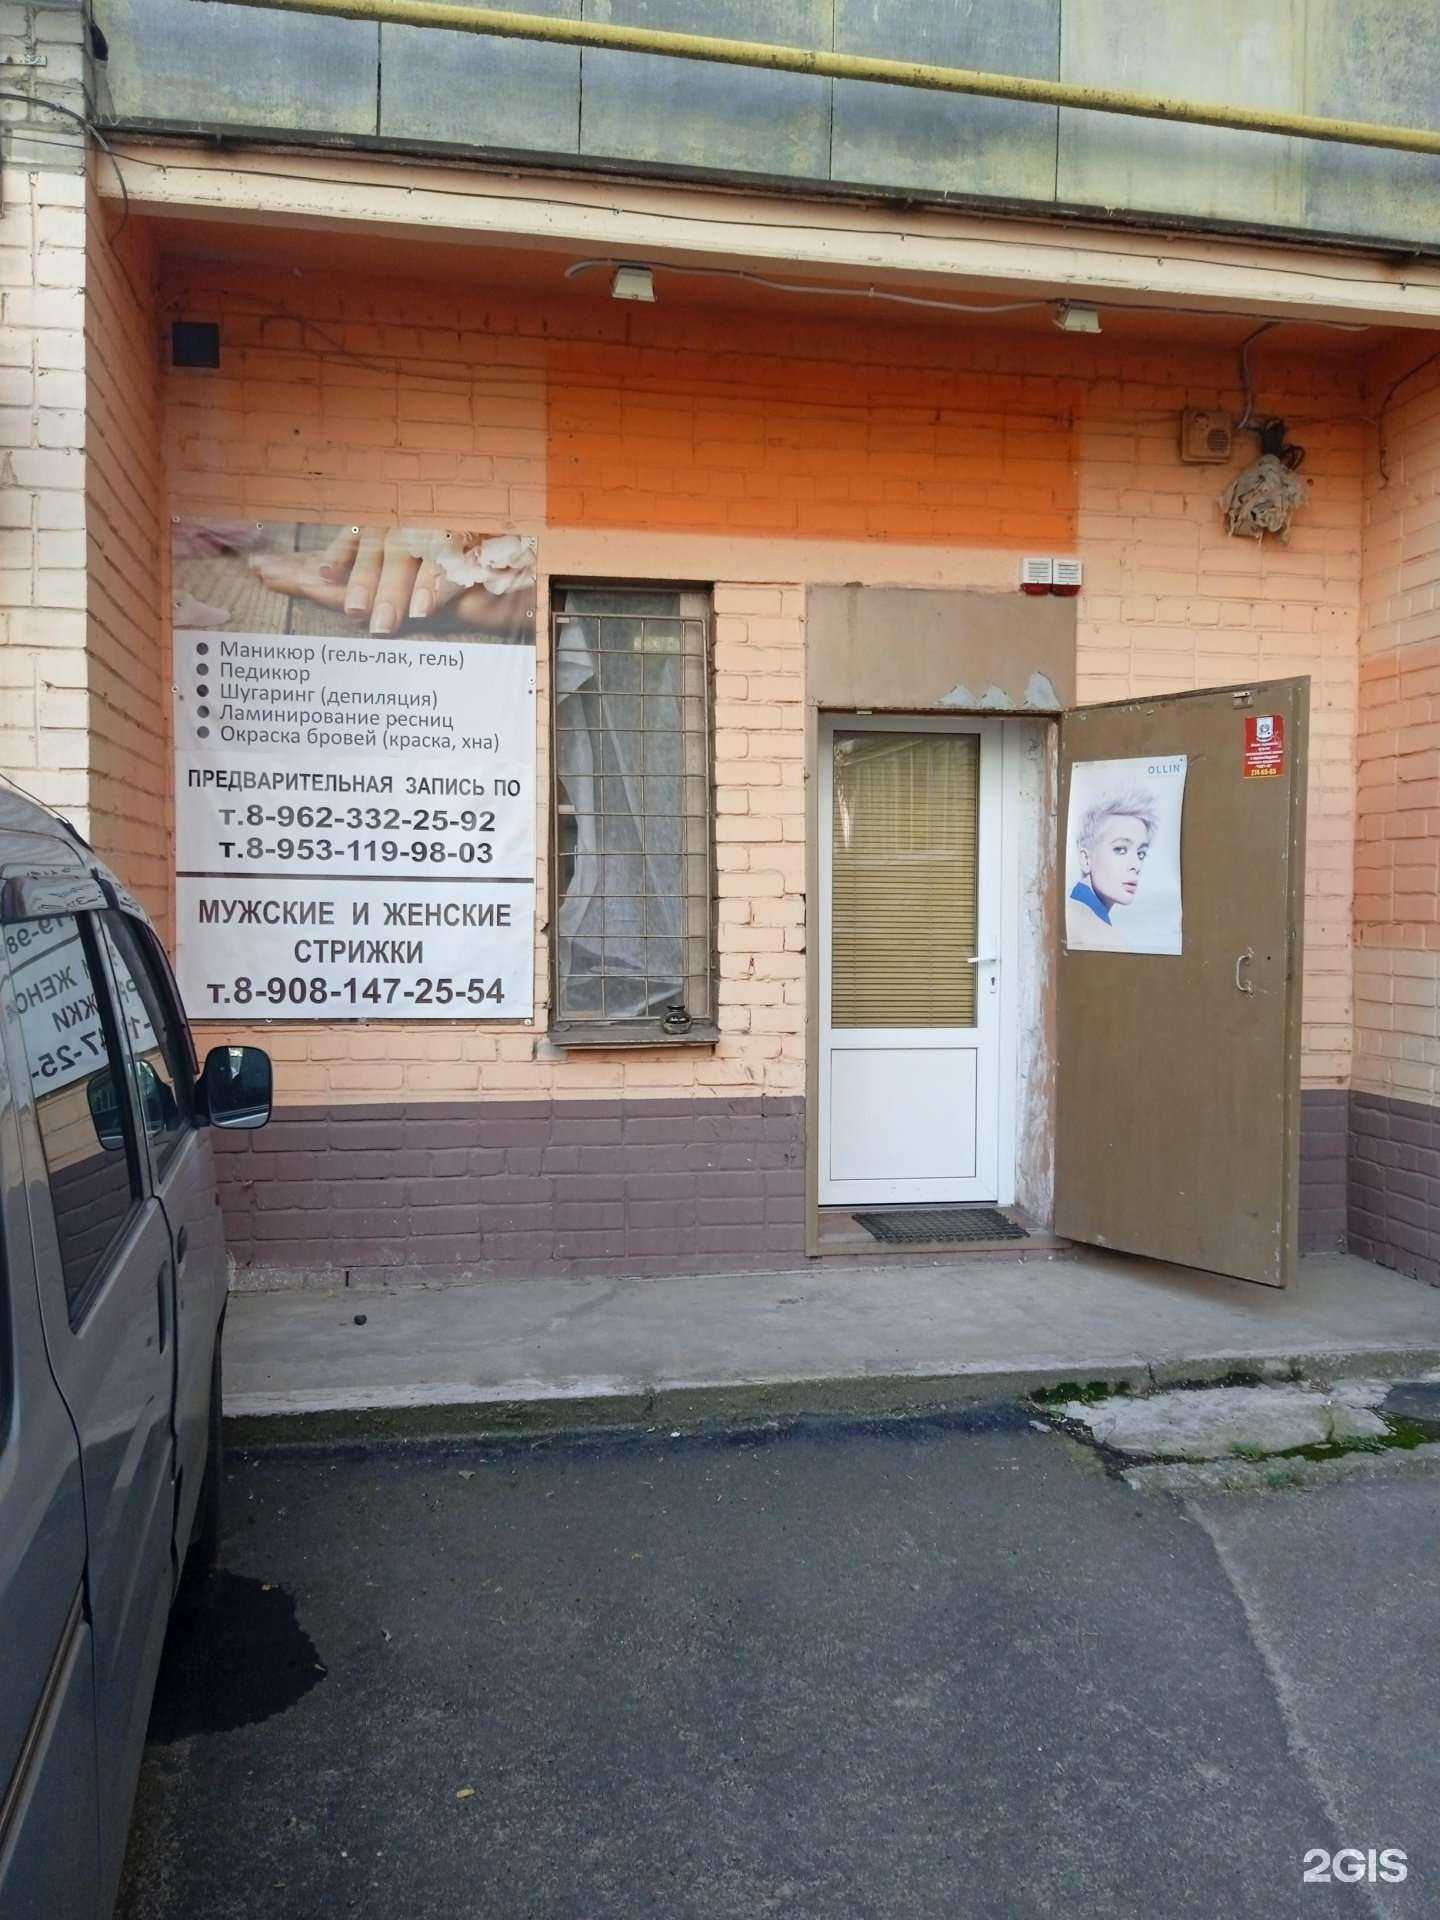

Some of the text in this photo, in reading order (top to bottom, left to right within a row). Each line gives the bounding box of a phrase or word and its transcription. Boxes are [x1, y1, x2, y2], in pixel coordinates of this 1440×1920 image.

[219, 640, 465, 670] Маникюр (гель-лак, гель)
[219, 662, 311, 682] Педикюр
[219, 683, 438, 709] Шугаринг (депиляция)
[219, 705, 454, 730] Ламинирование ресниц
[220, 725, 500, 752] Окраска бровей (краска, хна)
[1147, 763, 1181, 775] OLLIN
[188, 769, 521, 797] ПРЕДВАРИТЕЛЬНАЯ ЗАПИСЬ ПО
[218, 804, 496, 833] т.8-962-332-25-92
[218, 837, 493, 865] т.8-953-119-98-03
[199, 898, 512, 927] МУЖСКИЕ И ЖЕНСКИЕ
[294, 938, 424, 964] СТРИЖКИ
[207, 976, 506, 1005] т.8-908-147-25-54
